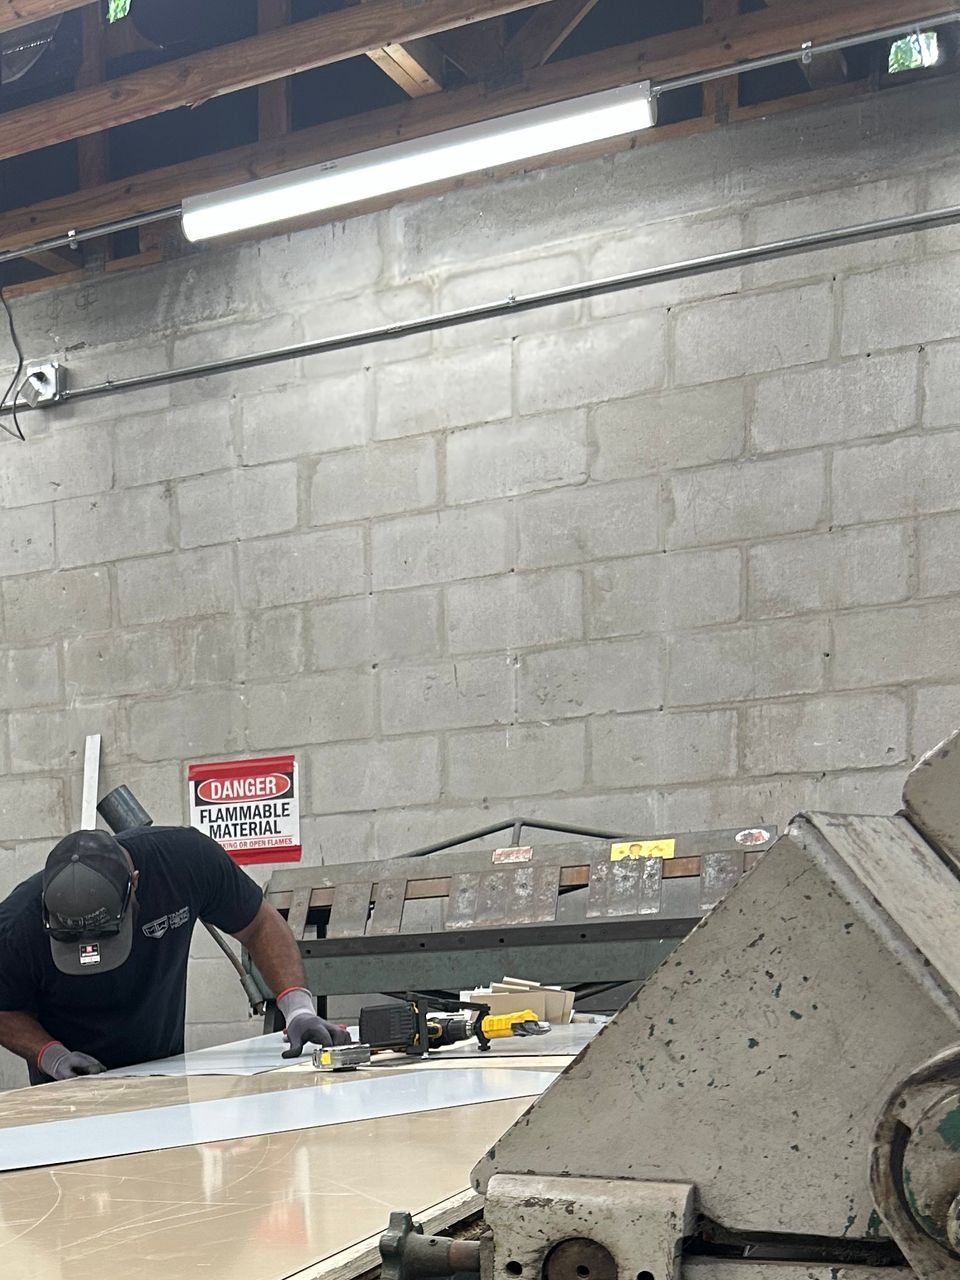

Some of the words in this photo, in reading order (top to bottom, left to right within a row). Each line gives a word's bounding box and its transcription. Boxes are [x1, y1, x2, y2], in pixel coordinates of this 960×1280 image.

[211, 777, 276, 800] DANGER
[200, 802, 290, 824] FLAMMABLE
[209, 820, 281, 839] MATERIAL
[222, 841, 238, 849] KING
[249, 838, 266, 847] OPEN
[267, 837, 292, 846] FLAMES
